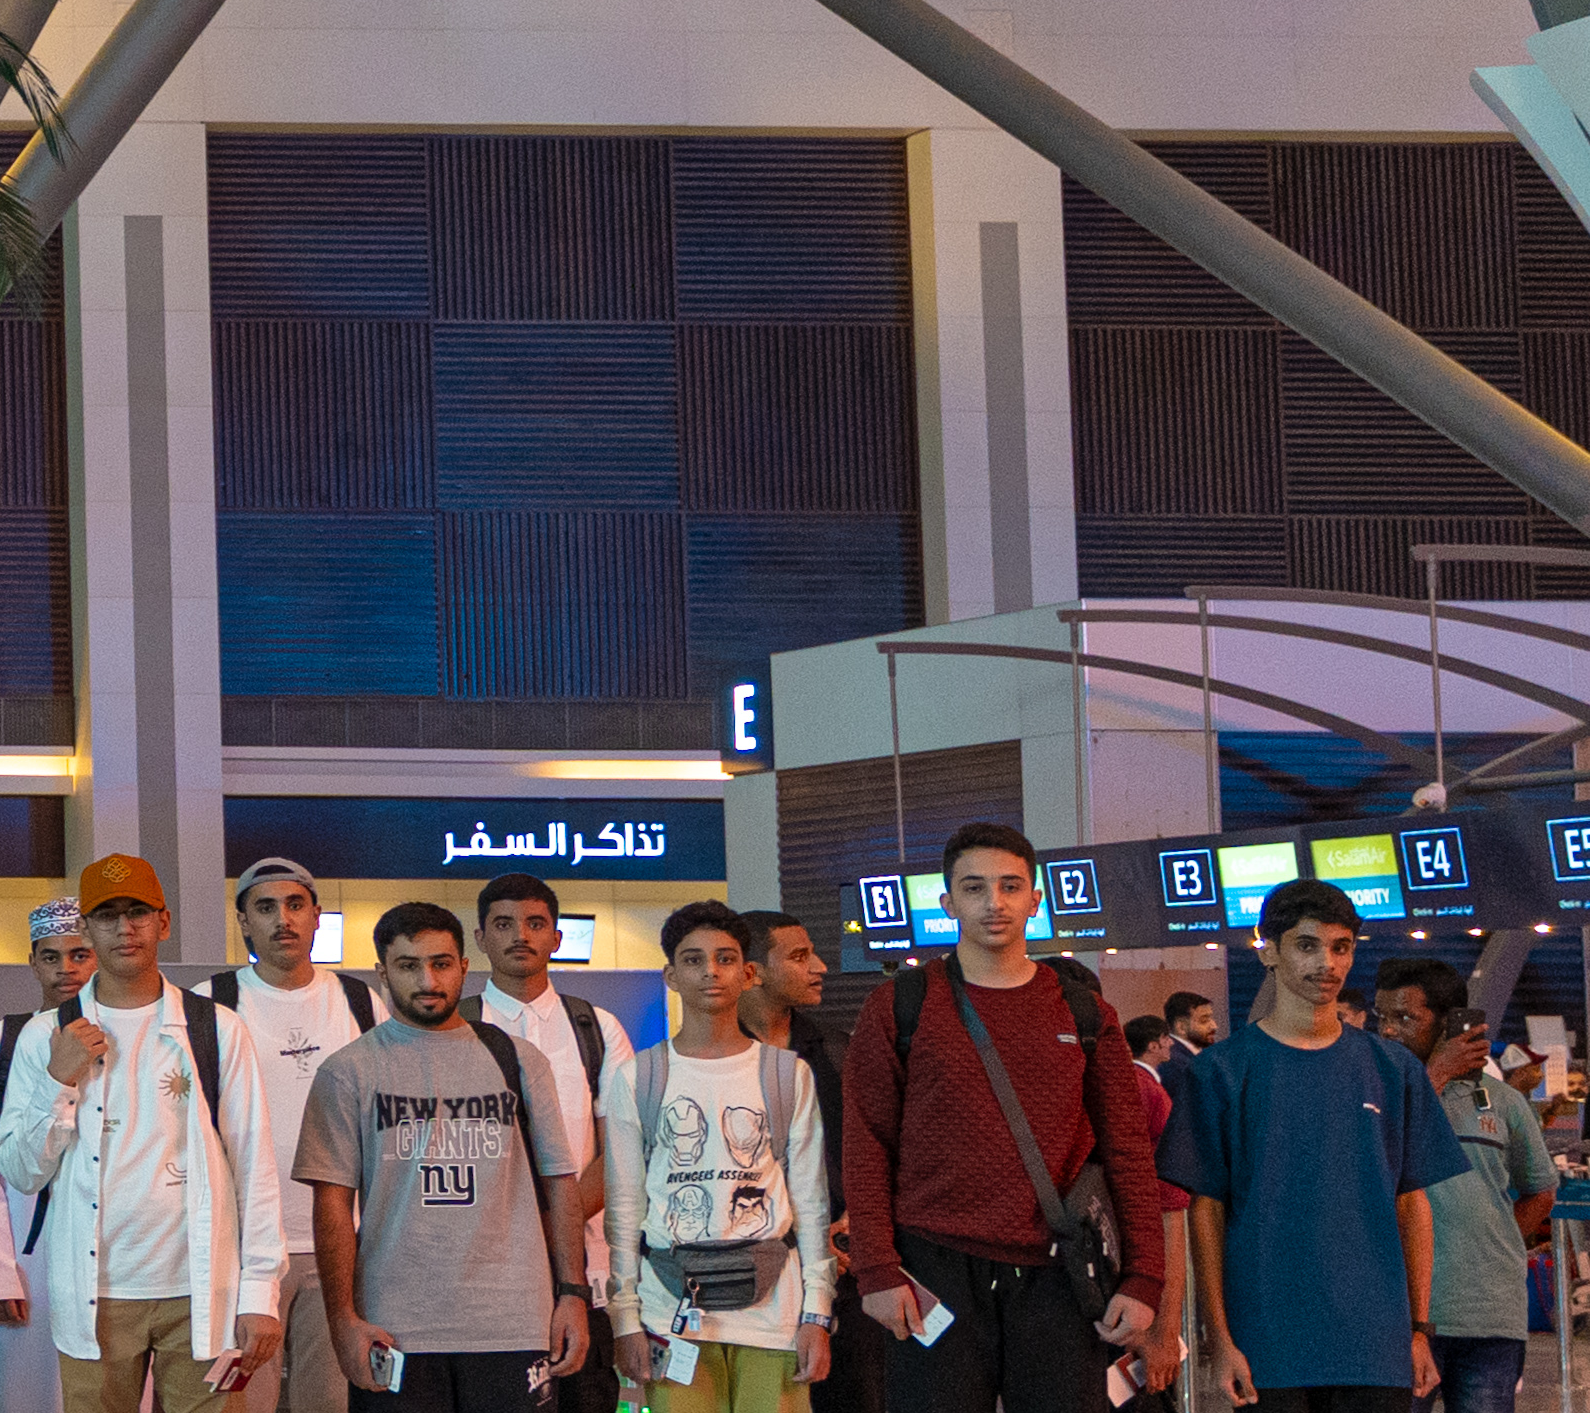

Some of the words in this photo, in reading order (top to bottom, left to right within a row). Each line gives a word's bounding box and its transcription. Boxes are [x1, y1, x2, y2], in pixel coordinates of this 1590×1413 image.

[733, 684, 757, 751] E
[441, 822, 567, 866] السفر
[571, 822, 666, 865] تذاكر
[1415, 838, 1451, 881] E4
[1058, 869, 1090, 906] E2
[1172, 858, 1202, 897] E3
[1348, 888, 1390, 907] IORITY
[871, 884, 897, 920] E1
[376, 1092, 437, 1132] NEW
[443, 1090, 516, 1127] YORK
[396, 1117, 502, 1160] GIANTS
[417, 1162, 477, 1208] ny
[666, 1169, 715, 1185] AVENGERS
